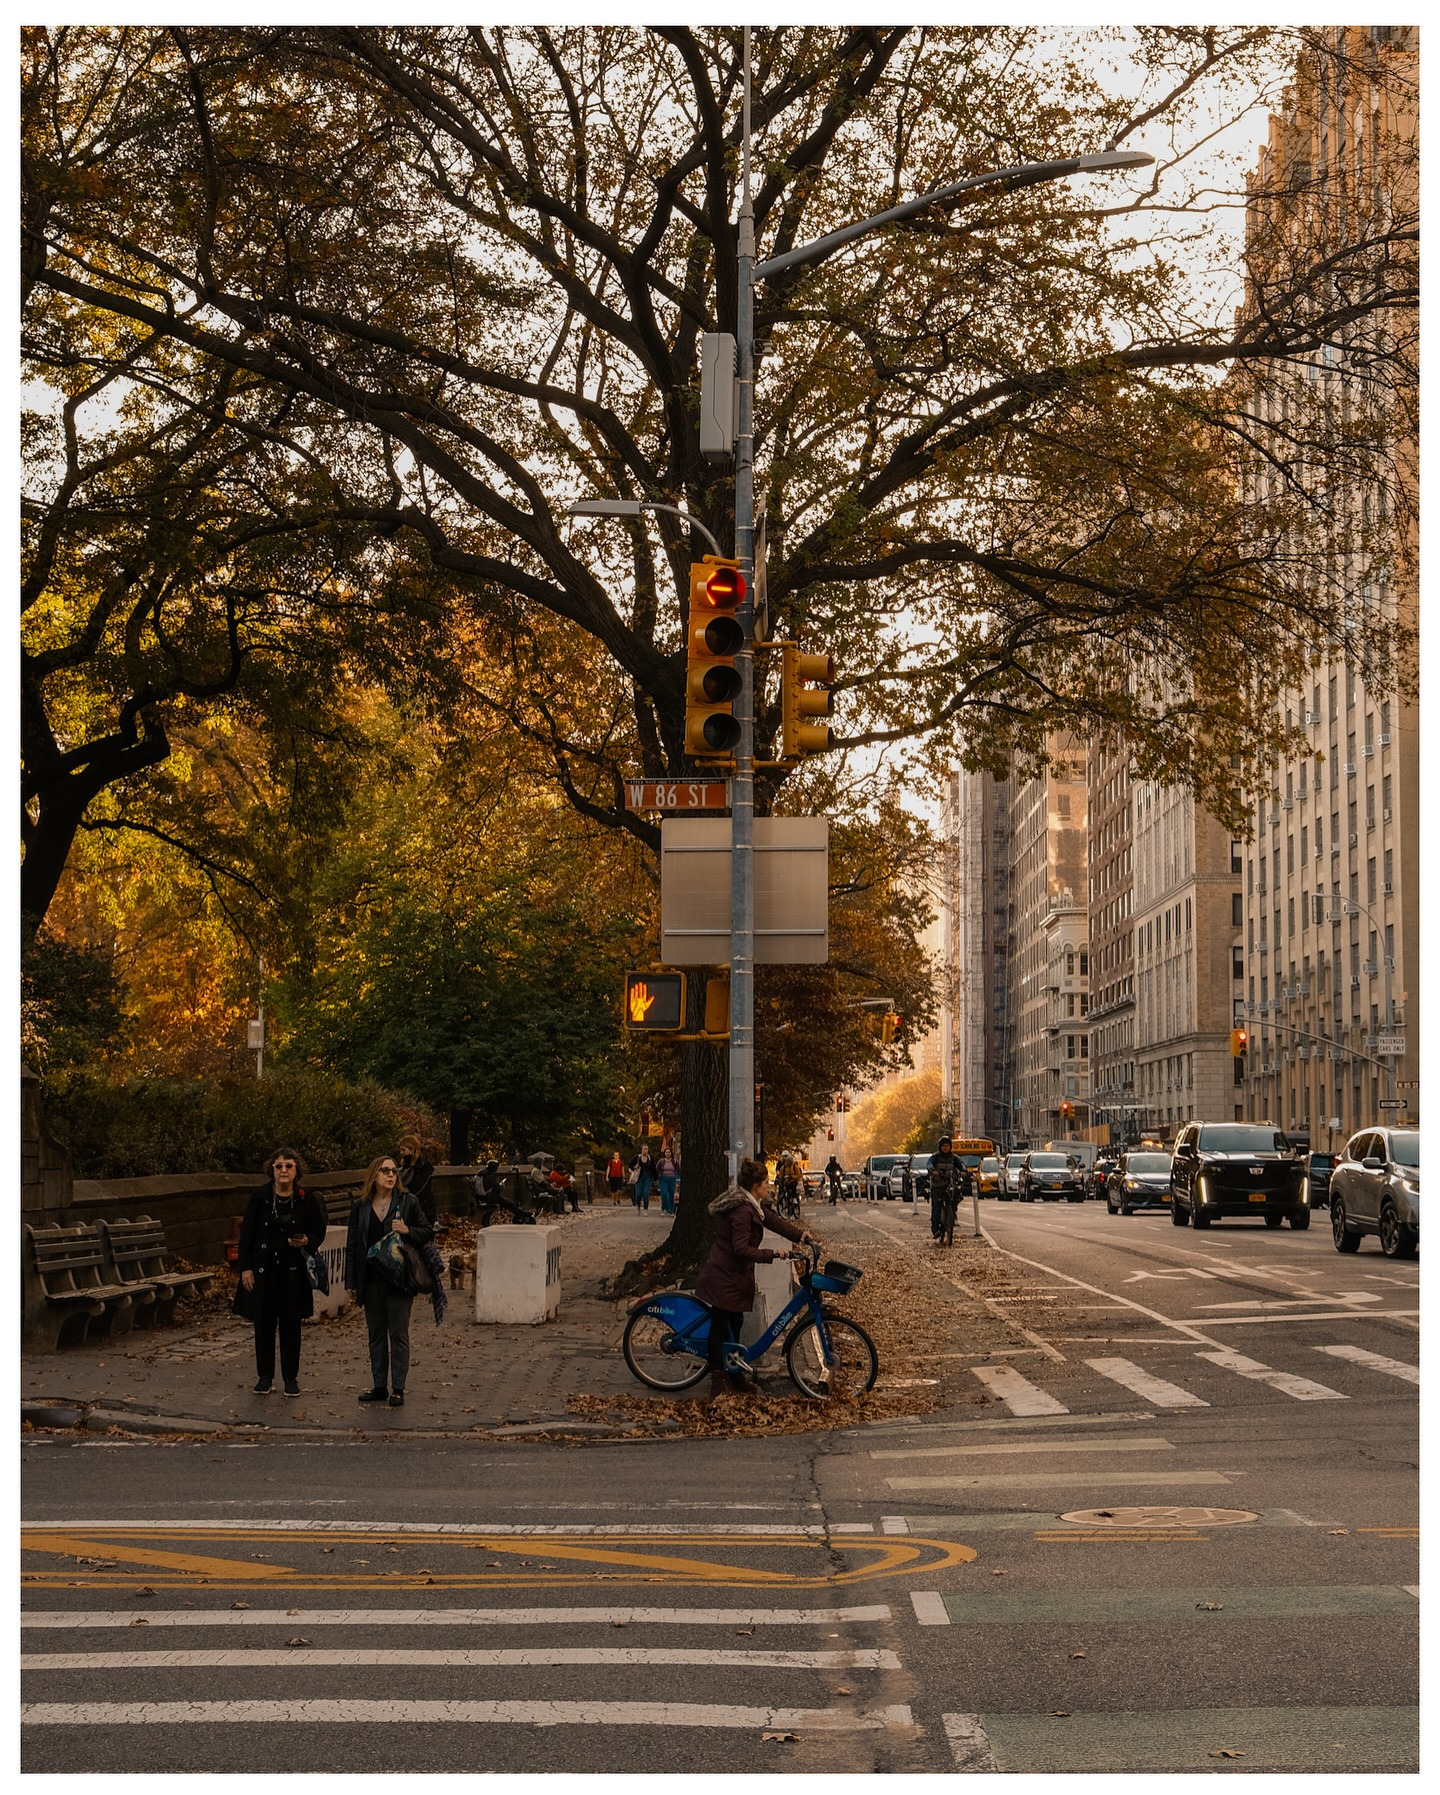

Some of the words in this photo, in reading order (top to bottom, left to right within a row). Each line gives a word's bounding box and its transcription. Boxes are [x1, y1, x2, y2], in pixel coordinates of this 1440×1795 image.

[630, 785, 644, 807] W
[655, 784, 677, 807] 86
[688, 784, 708, 806] ST
